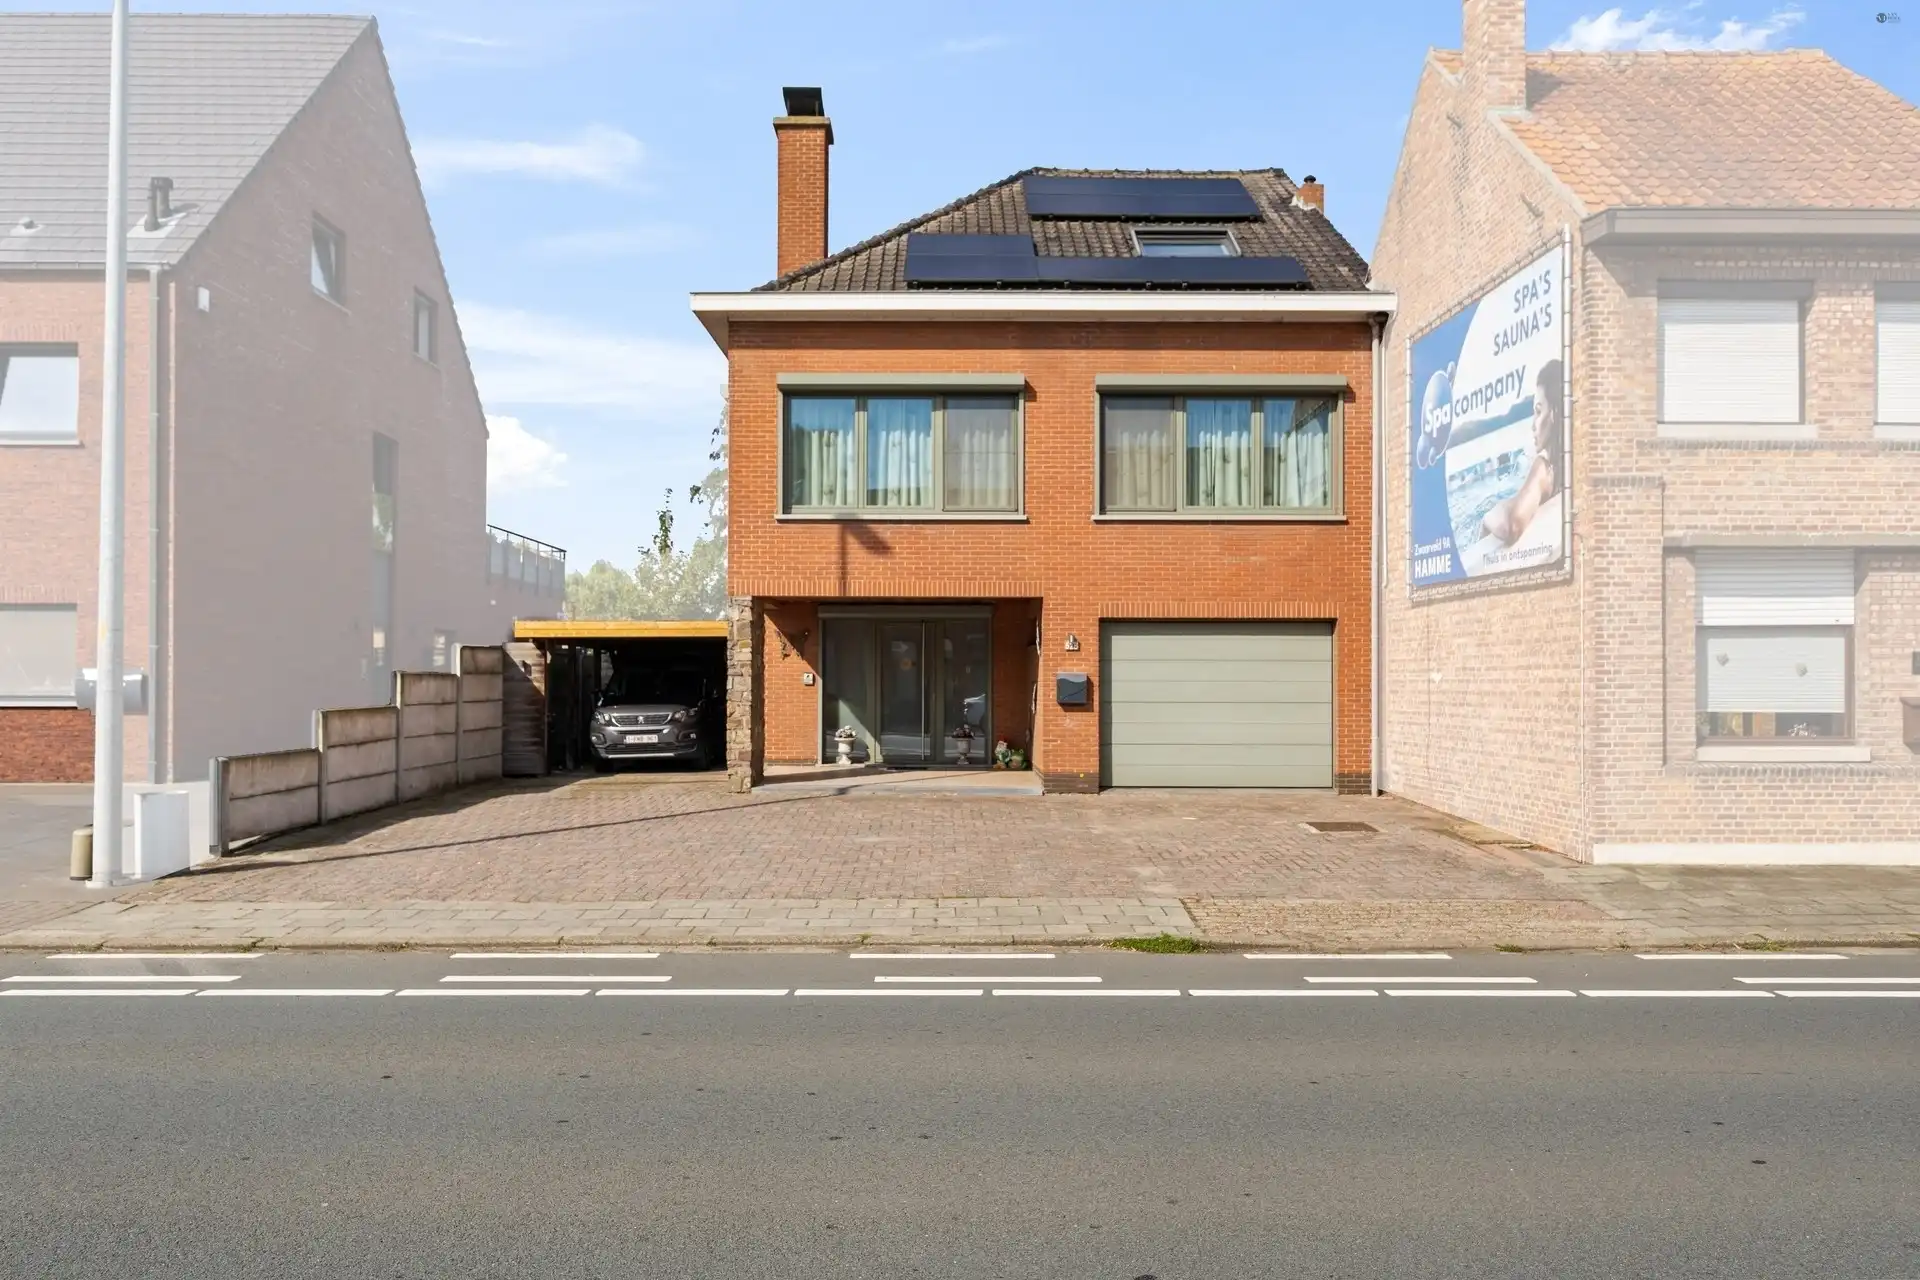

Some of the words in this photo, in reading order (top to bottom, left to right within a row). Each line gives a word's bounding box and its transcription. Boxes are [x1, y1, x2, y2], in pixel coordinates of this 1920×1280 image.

[1514, 270, 1552, 313] SPA'S
[1493, 304, 1552, 356] SAUNA'S
[1414, 554, 1451, 578] HAMME
